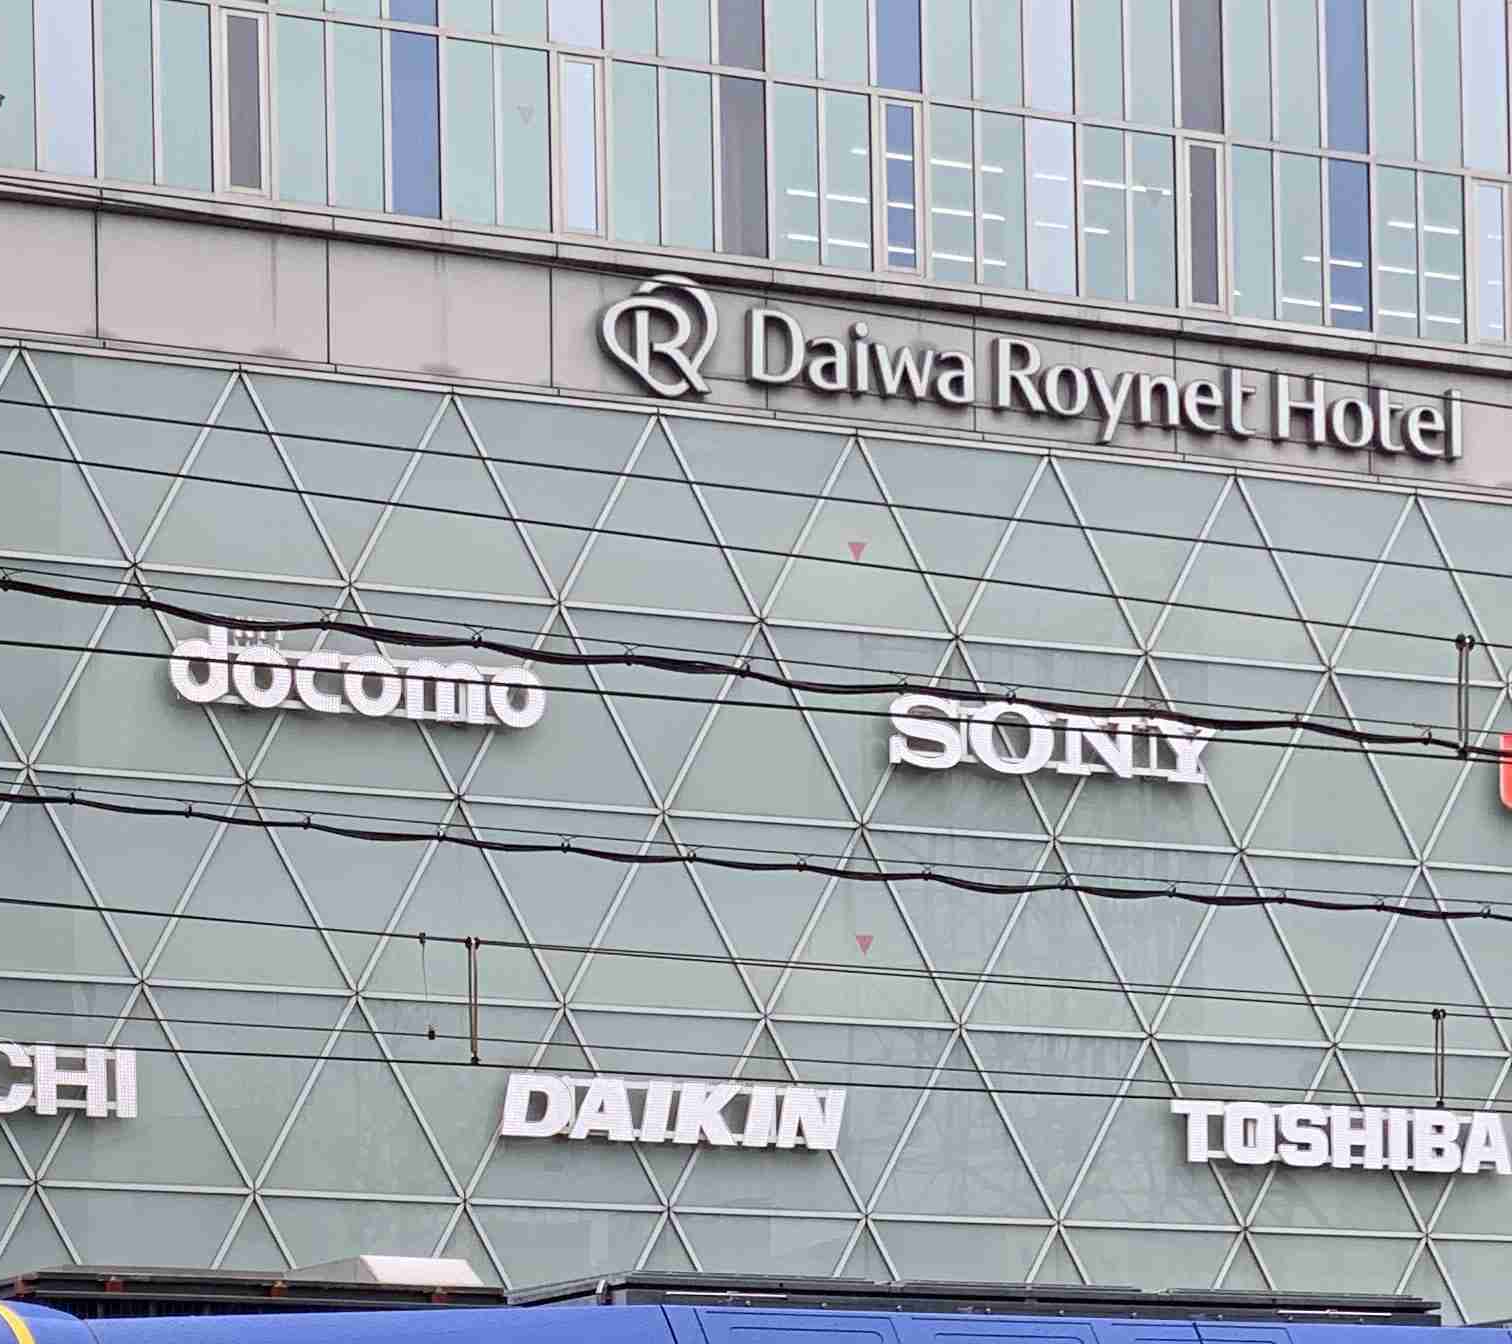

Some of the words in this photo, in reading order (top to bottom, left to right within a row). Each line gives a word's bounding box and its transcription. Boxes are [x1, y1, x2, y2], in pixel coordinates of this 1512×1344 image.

[747, 308, 976, 404] Daiwa
[995, 336, 1256, 444] Roynet
[1276, 372, 1464, 460] Hotel
[169, 622, 546, 729] docomo
[888, 693, 1216, 785] SONY
[501, 1072, 847, 1150] DAIKIN
[1170, 1099, 1512, 1174] TOSHIBA
